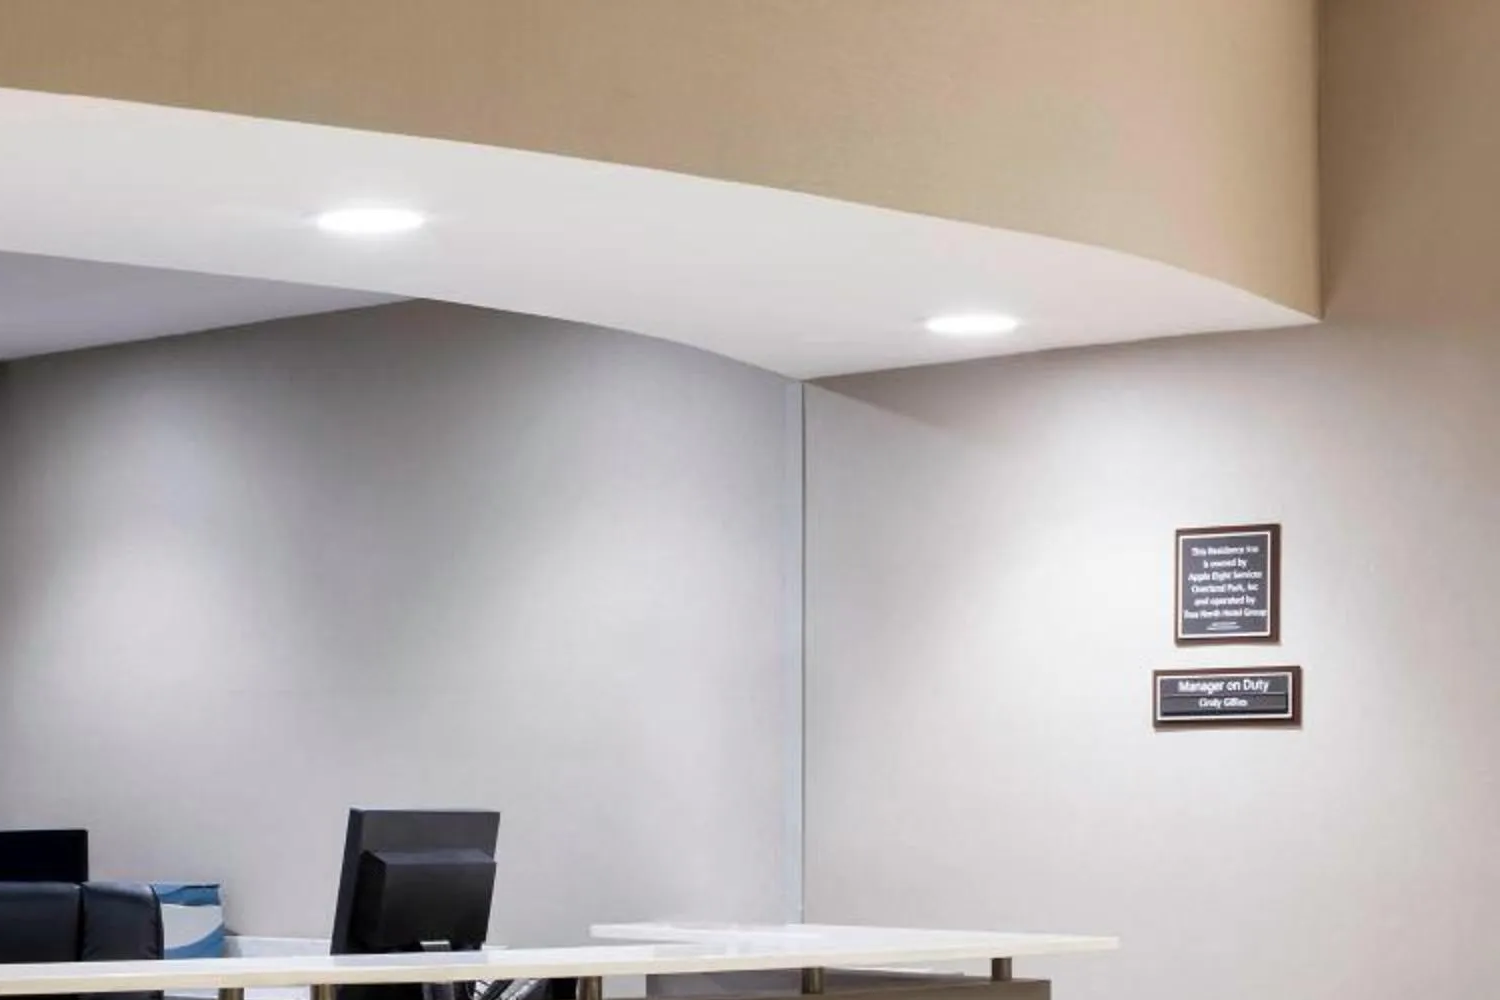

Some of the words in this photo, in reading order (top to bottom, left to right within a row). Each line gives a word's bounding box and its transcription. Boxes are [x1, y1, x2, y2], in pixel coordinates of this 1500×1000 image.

[1238, 558, 1248, 569] by
[1187, 572, 1210, 582] Apple
[1194, 597, 1209, 606] and
[1245, 595, 1256, 606] by
[1178, 679, 1225, 694] Manager
[1226, 681, 1241, 692] on
[1243, 679, 1269, 693] Duty
[1199, 698, 1221, 709] Cindy
